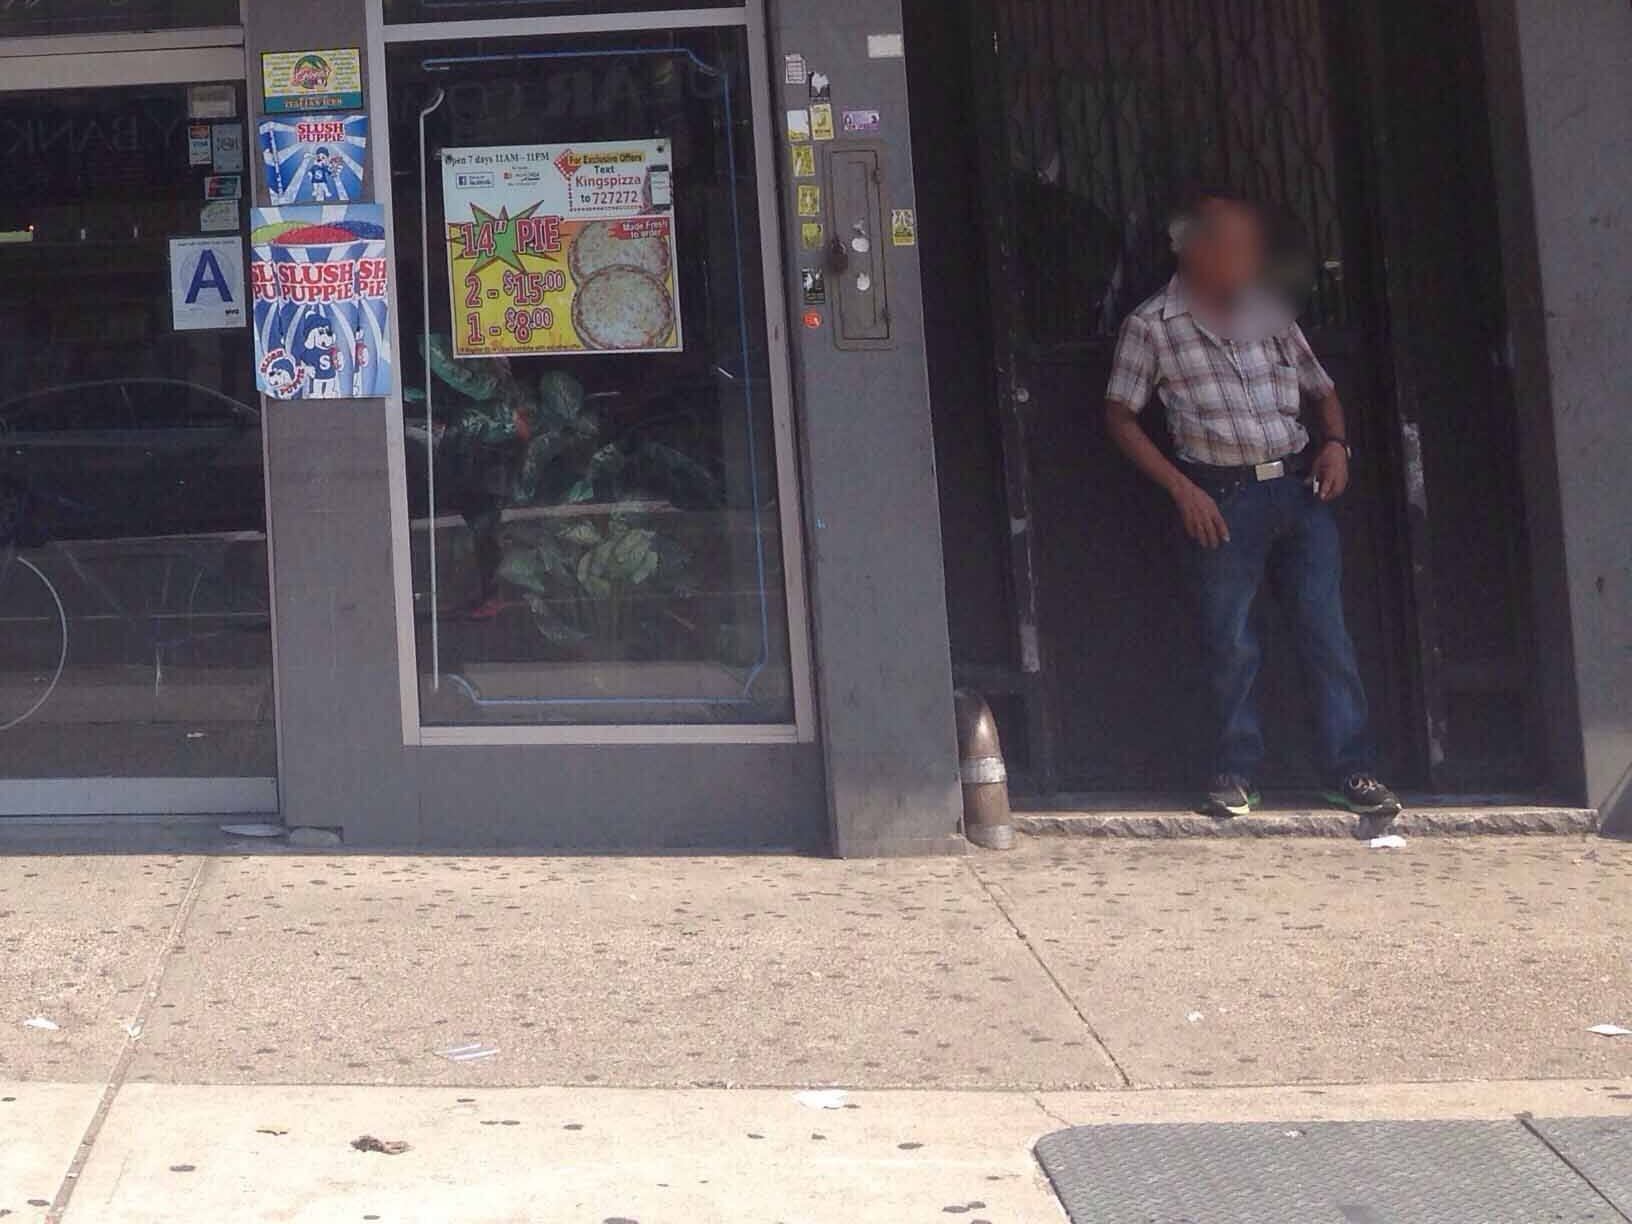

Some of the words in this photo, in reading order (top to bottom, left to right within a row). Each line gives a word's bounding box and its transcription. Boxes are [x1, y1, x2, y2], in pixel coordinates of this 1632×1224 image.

[297, 122, 344, 134] SLUSH
[594, 165, 615, 174] Text
[576, 175, 641, 189] Kingspizza
[581, 194, 591, 203] to
[592, 190, 639, 204] 727272
[516, 215, 561, 254] PIE
[184, 248, 234, 305] A
[278, 261, 353, 284] SLUSH
[465, 274, 483, 307] 2
